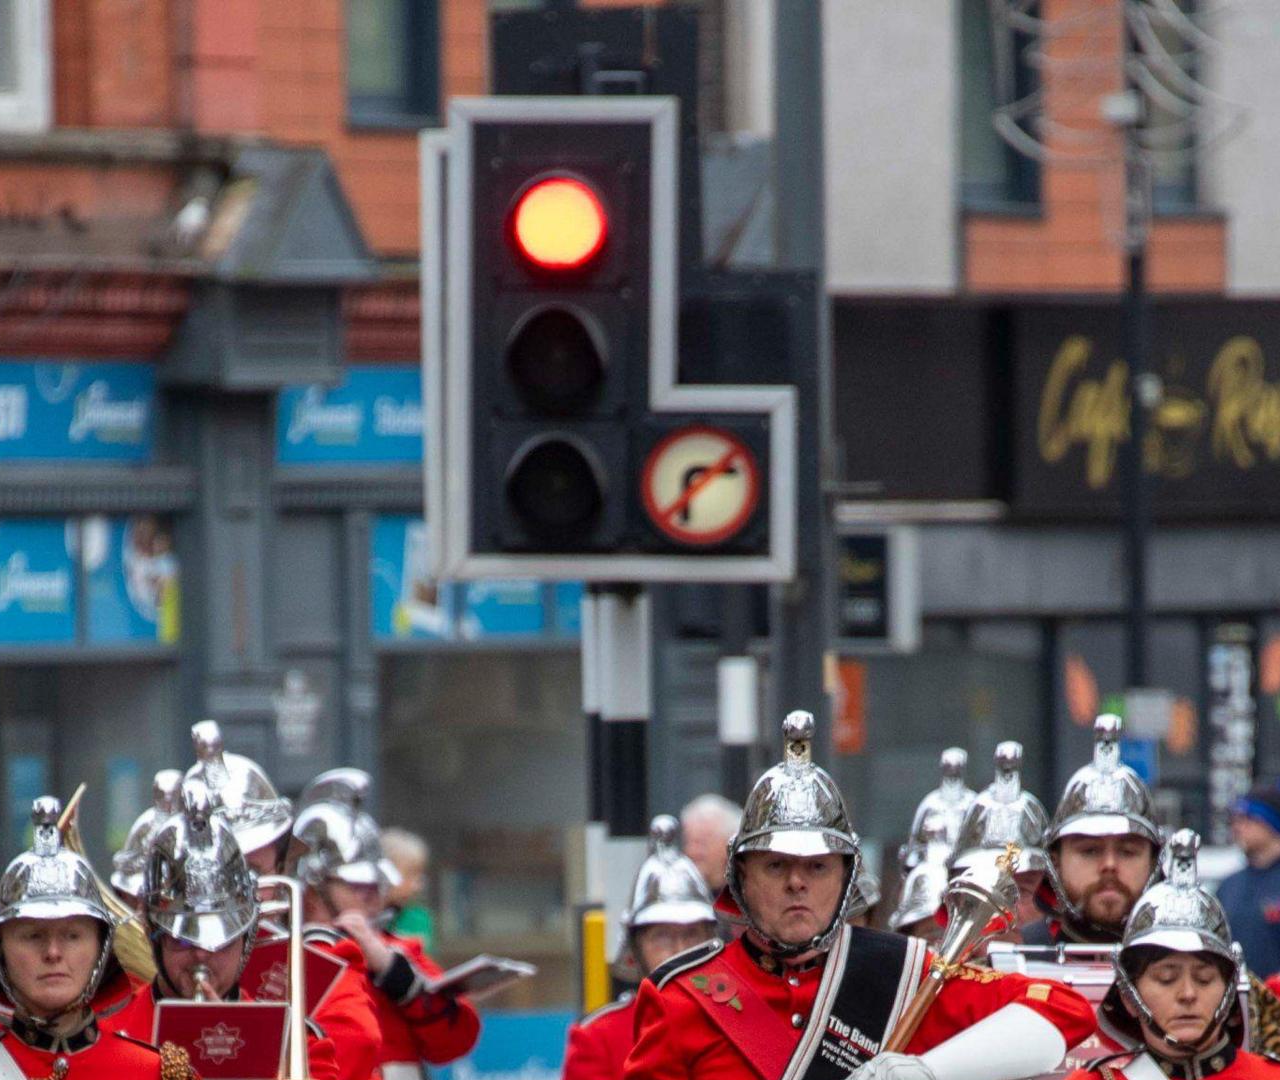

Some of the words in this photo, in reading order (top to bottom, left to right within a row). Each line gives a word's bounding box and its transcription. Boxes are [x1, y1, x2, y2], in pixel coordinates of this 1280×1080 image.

[828, 1015, 850, 1038] The
[850, 1028, 880, 1055] Band
[822, 1039, 840, 1055] West
[839, 1039, 849, 1048] of
[847, 1042, 859, 1055] the
[821, 1048, 835, 1064] Fire
